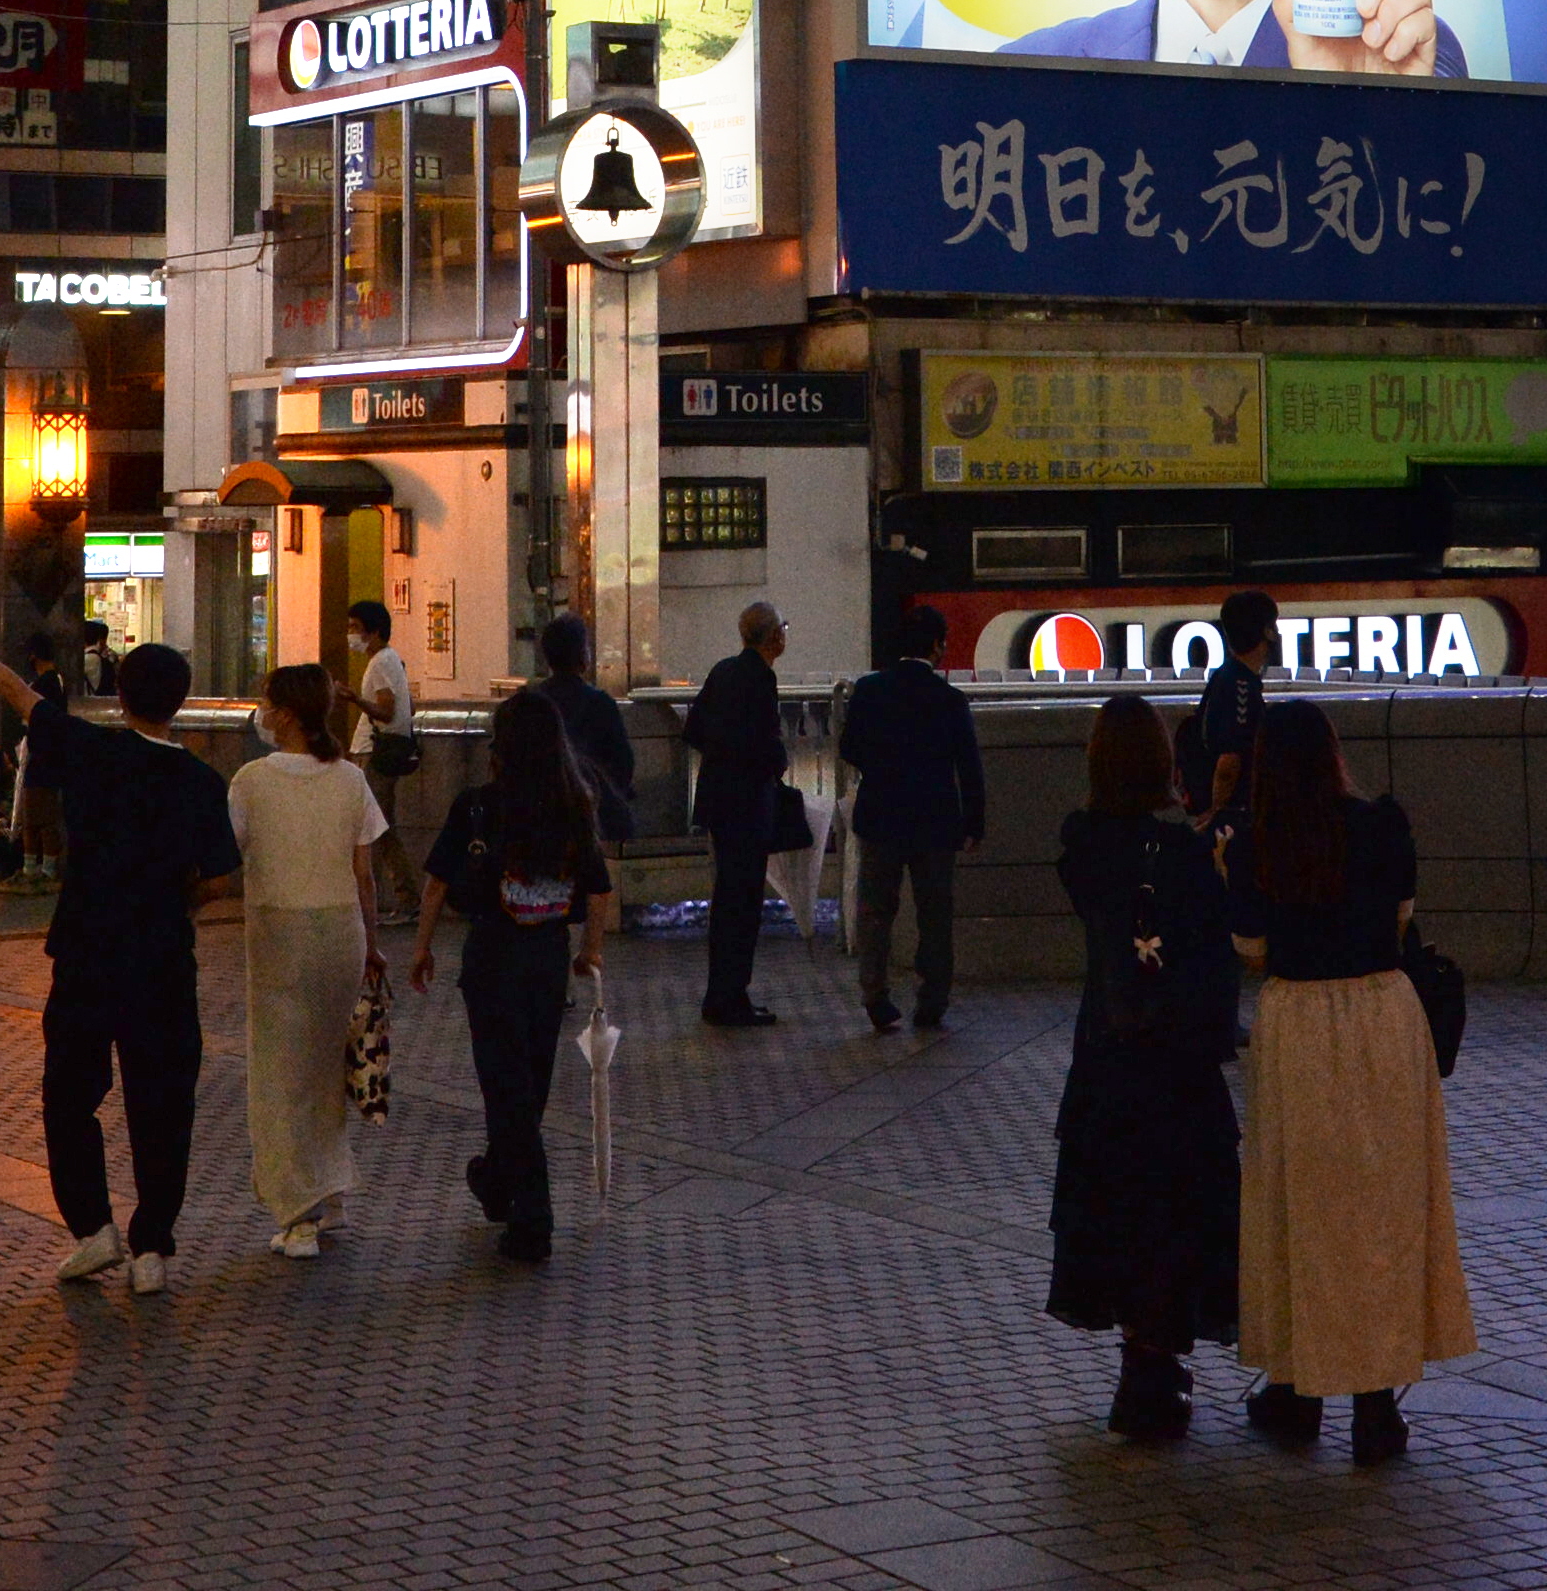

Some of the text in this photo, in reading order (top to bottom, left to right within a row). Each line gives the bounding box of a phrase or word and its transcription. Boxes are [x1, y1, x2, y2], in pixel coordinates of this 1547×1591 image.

[722, 164, 749, 190] 近鉄
[938, 118, 1487, 258] 明日を、元気に!
[371, 388, 426, 420] Toilets
[724, 383, 825, 415] Toilets
[1369, 372, 1493, 444] ピタットハウス
[969, 460, 1040, 481] 株式会社
[1125, 612, 1481, 681] LOTERIA
